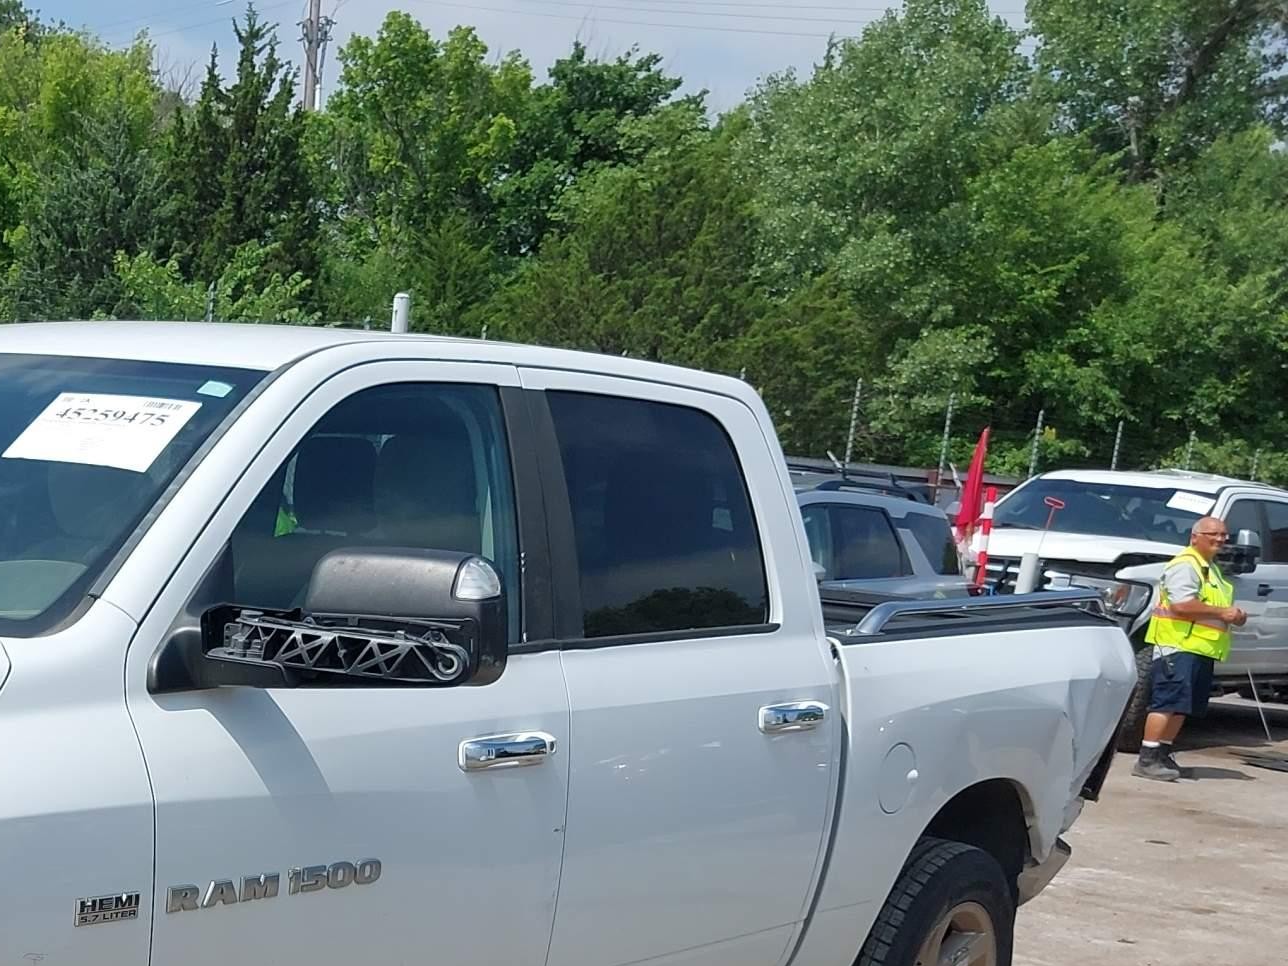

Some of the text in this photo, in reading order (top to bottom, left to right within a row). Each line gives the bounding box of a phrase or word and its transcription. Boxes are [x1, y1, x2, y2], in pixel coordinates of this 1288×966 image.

[56, 408, 170, 426] 45259475
[166, 858, 382, 914] RAM 1500
[79, 894, 140, 912] HEMI
[80, 910, 136, 923] 5.7 LITER
